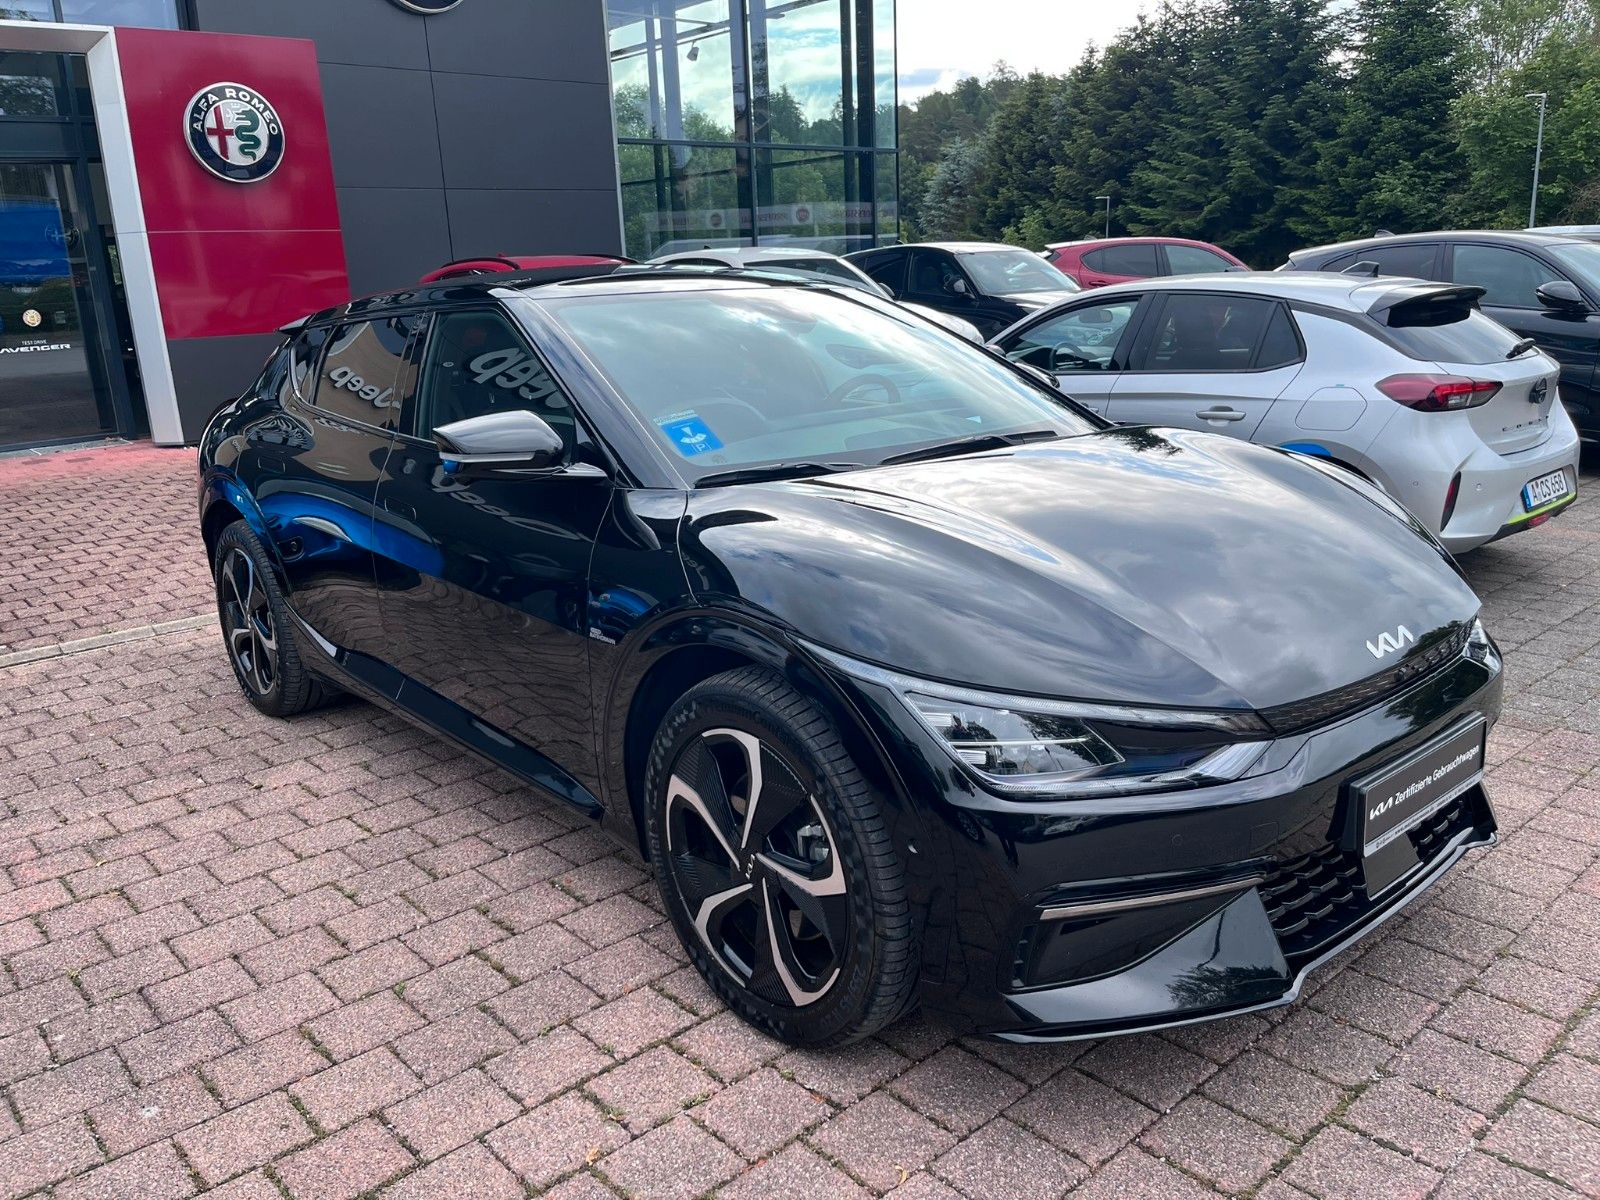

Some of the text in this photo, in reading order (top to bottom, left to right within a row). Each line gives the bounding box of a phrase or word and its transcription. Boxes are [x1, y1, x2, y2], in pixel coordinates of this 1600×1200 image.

[193, 88, 278, 135] ALFA ROMEO
[0, 343, 71, 354] AVENGER
[1366, 624, 1414, 659] KIA
[1369, 744, 1479, 820] KIA Zertifizierte Gebrauchtwagen
